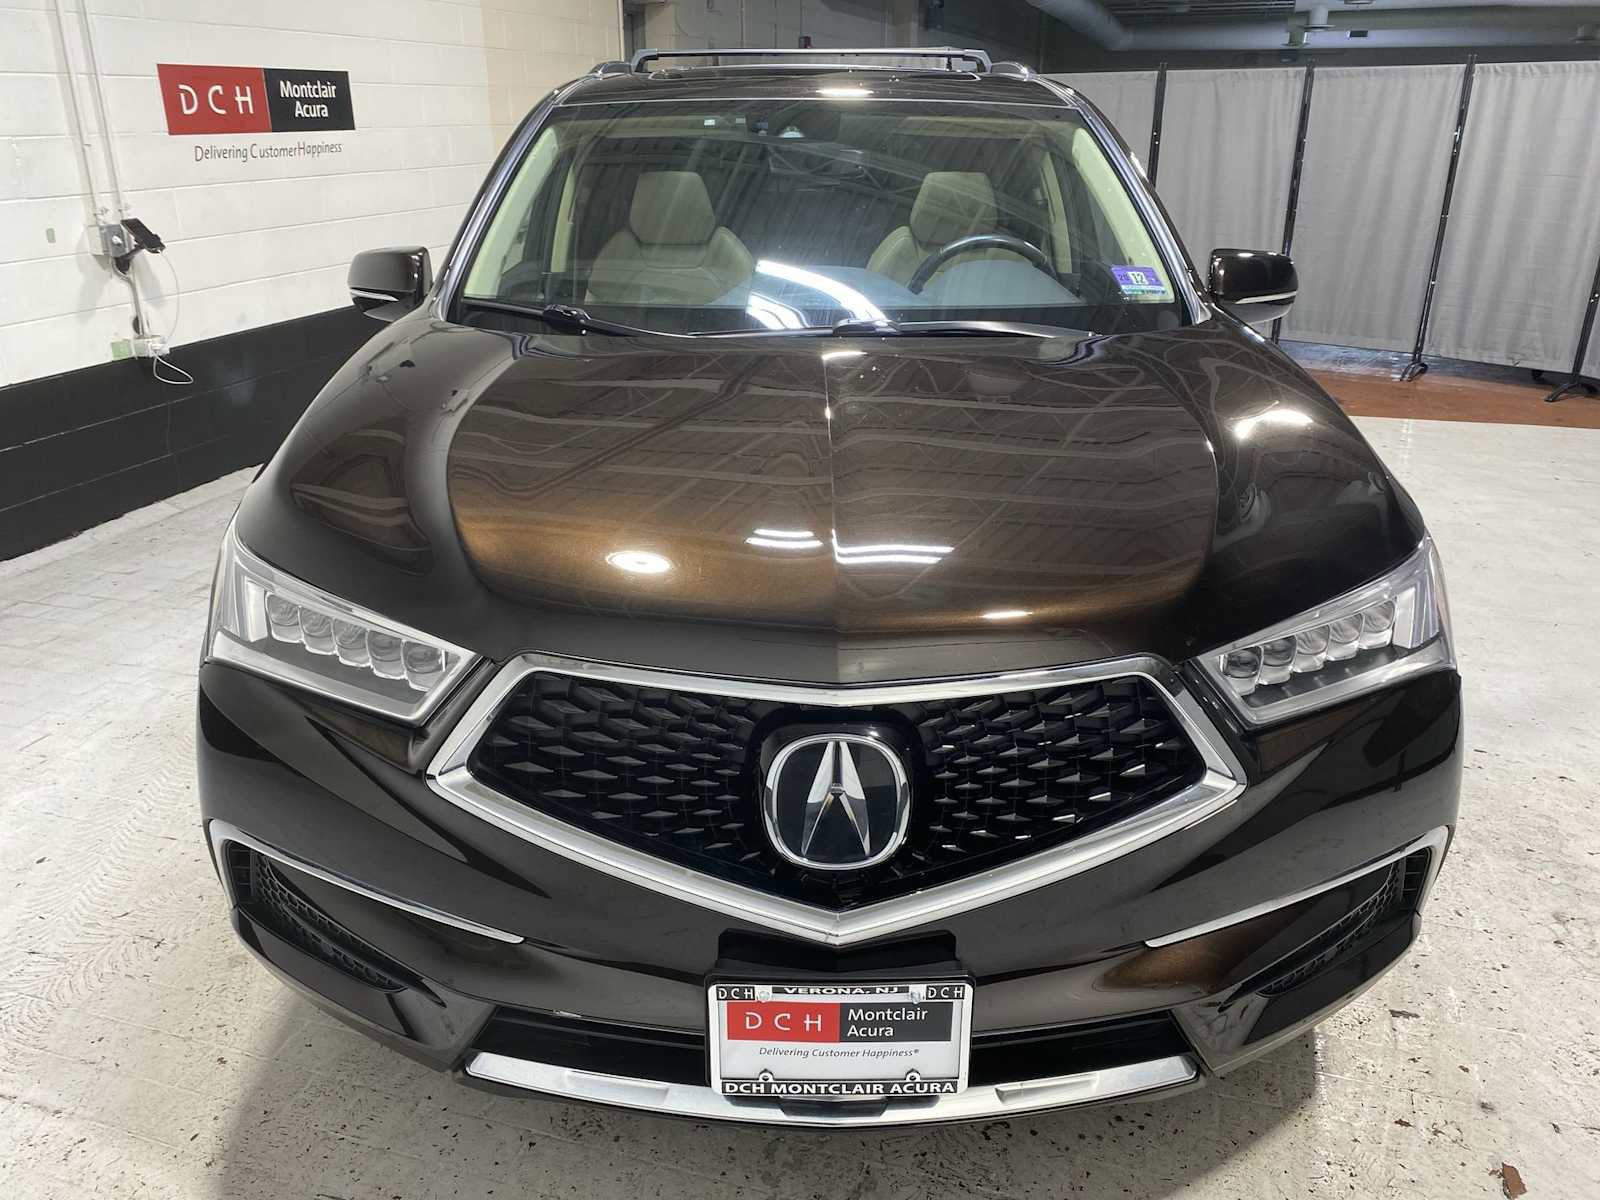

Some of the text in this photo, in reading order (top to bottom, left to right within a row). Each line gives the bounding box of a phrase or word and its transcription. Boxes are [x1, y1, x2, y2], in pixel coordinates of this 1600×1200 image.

[279, 80, 337, 99] Montclair
[178, 84, 254, 115] DCH
[295, 101, 329, 118] Acura
[194, 145, 248, 163] Delivering
[719, 988, 754, 1000] DCH
[875, 987, 899, 995] NJ
[928, 987, 963, 998] DCH
[848, 1008, 928, 1021] Montclair
[745, 1012, 822, 1032] DCH
[847, 1025, 894, 1037] Acura
[759, 1047, 809, 1058] Delivering
[812, 1048, 860, 1057] Customer
[725, 1083, 954, 1095] DCH MONTCLAIR ACURA
